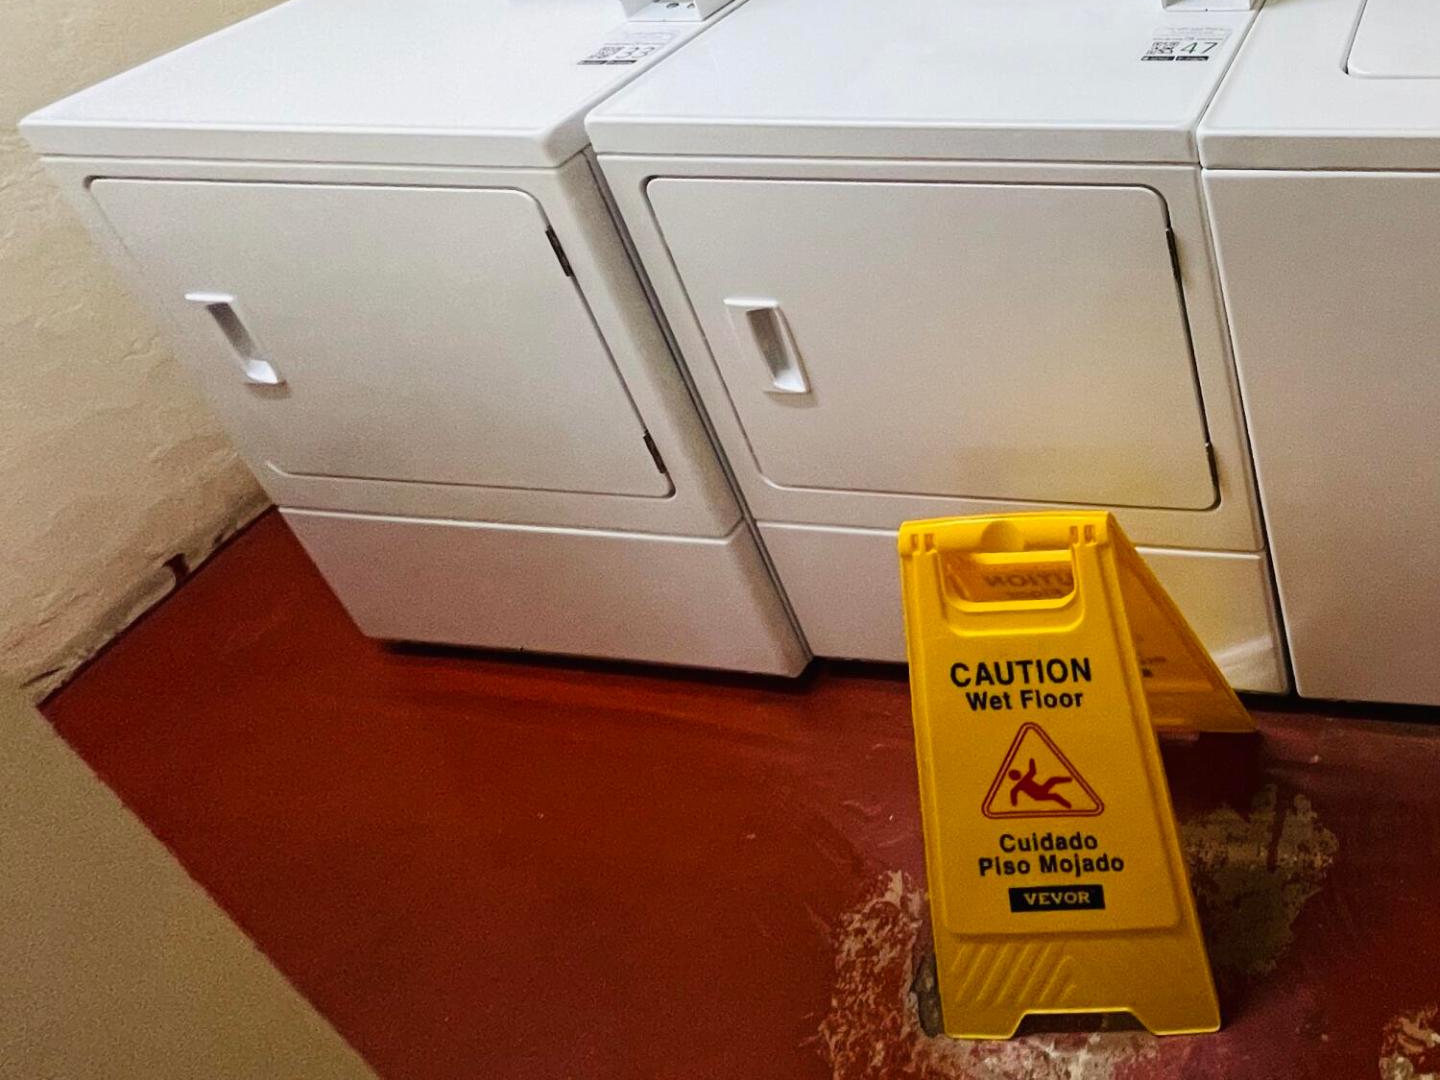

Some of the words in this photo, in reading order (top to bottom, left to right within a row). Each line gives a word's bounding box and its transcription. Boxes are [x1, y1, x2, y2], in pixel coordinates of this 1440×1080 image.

[1180, 41, 1219, 55] 47
[950, 657, 1093, 688] CAUTION
[965, 690, 1013, 712] Wet
[1020, 689, 1084, 710] Floor
[999, 831, 1098, 853] Cuidado
[978, 855, 1031, 877] Piso
[1038, 852, 1125, 878] Mojado
[1024, 891, 1091, 906] VEVOR
